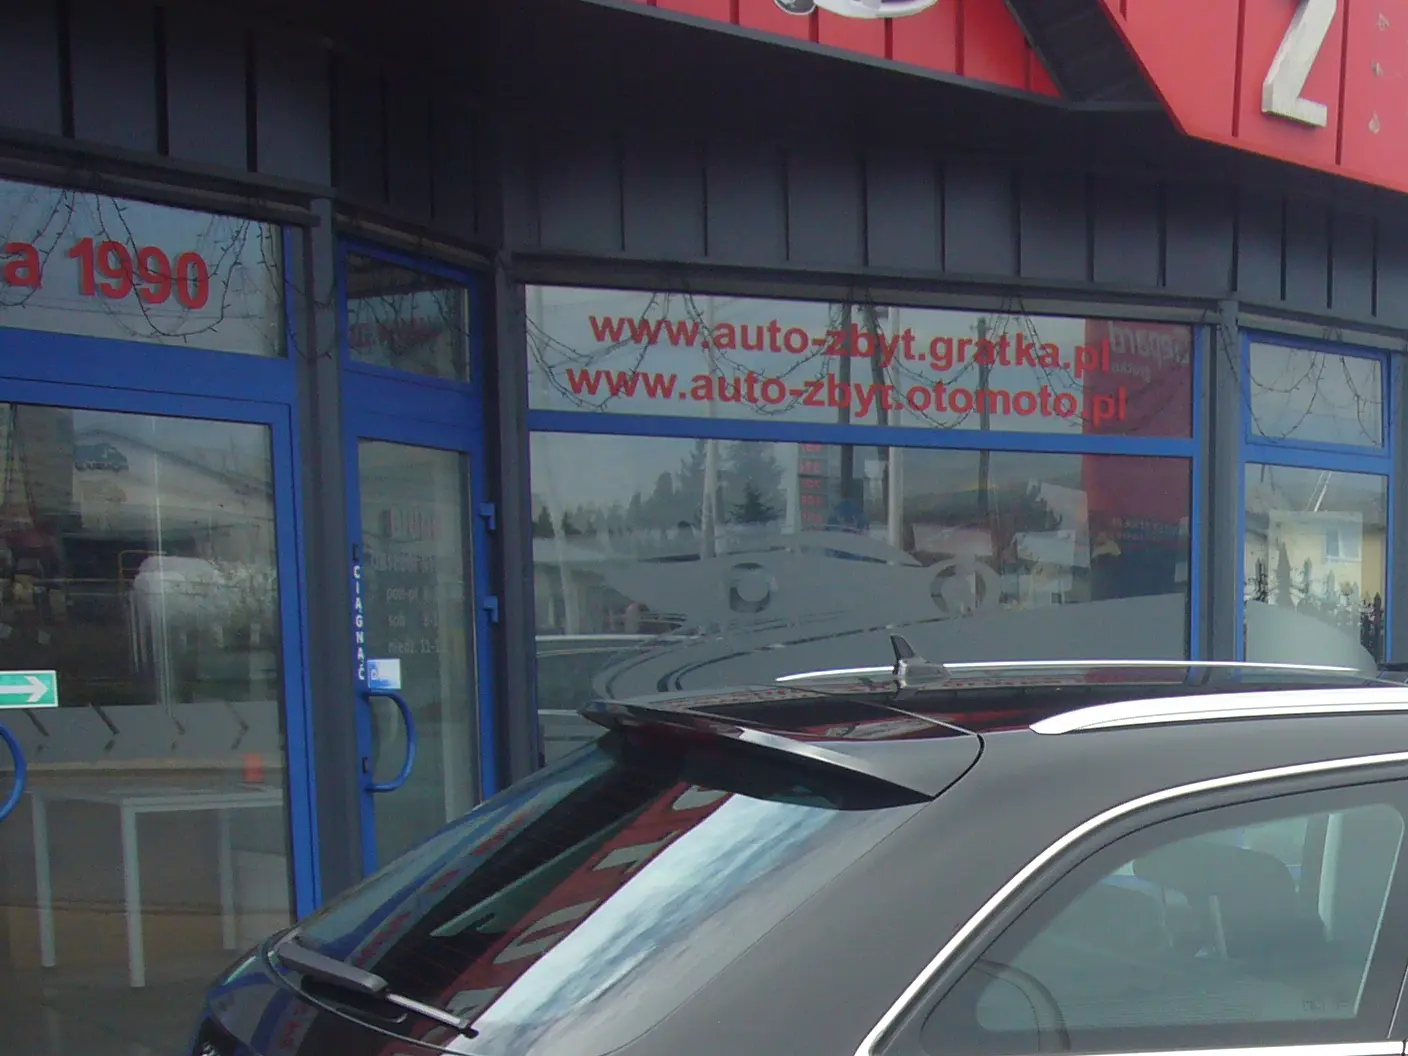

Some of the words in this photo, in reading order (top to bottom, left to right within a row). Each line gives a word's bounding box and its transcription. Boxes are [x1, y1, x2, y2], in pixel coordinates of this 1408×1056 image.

[67, 237, 210, 310] 1990
[588, 314, 1112, 378] www.auto-zbyt.gratka.pl
[565, 367, 1127, 428] www.auto-zbyt.otomoto.pl
